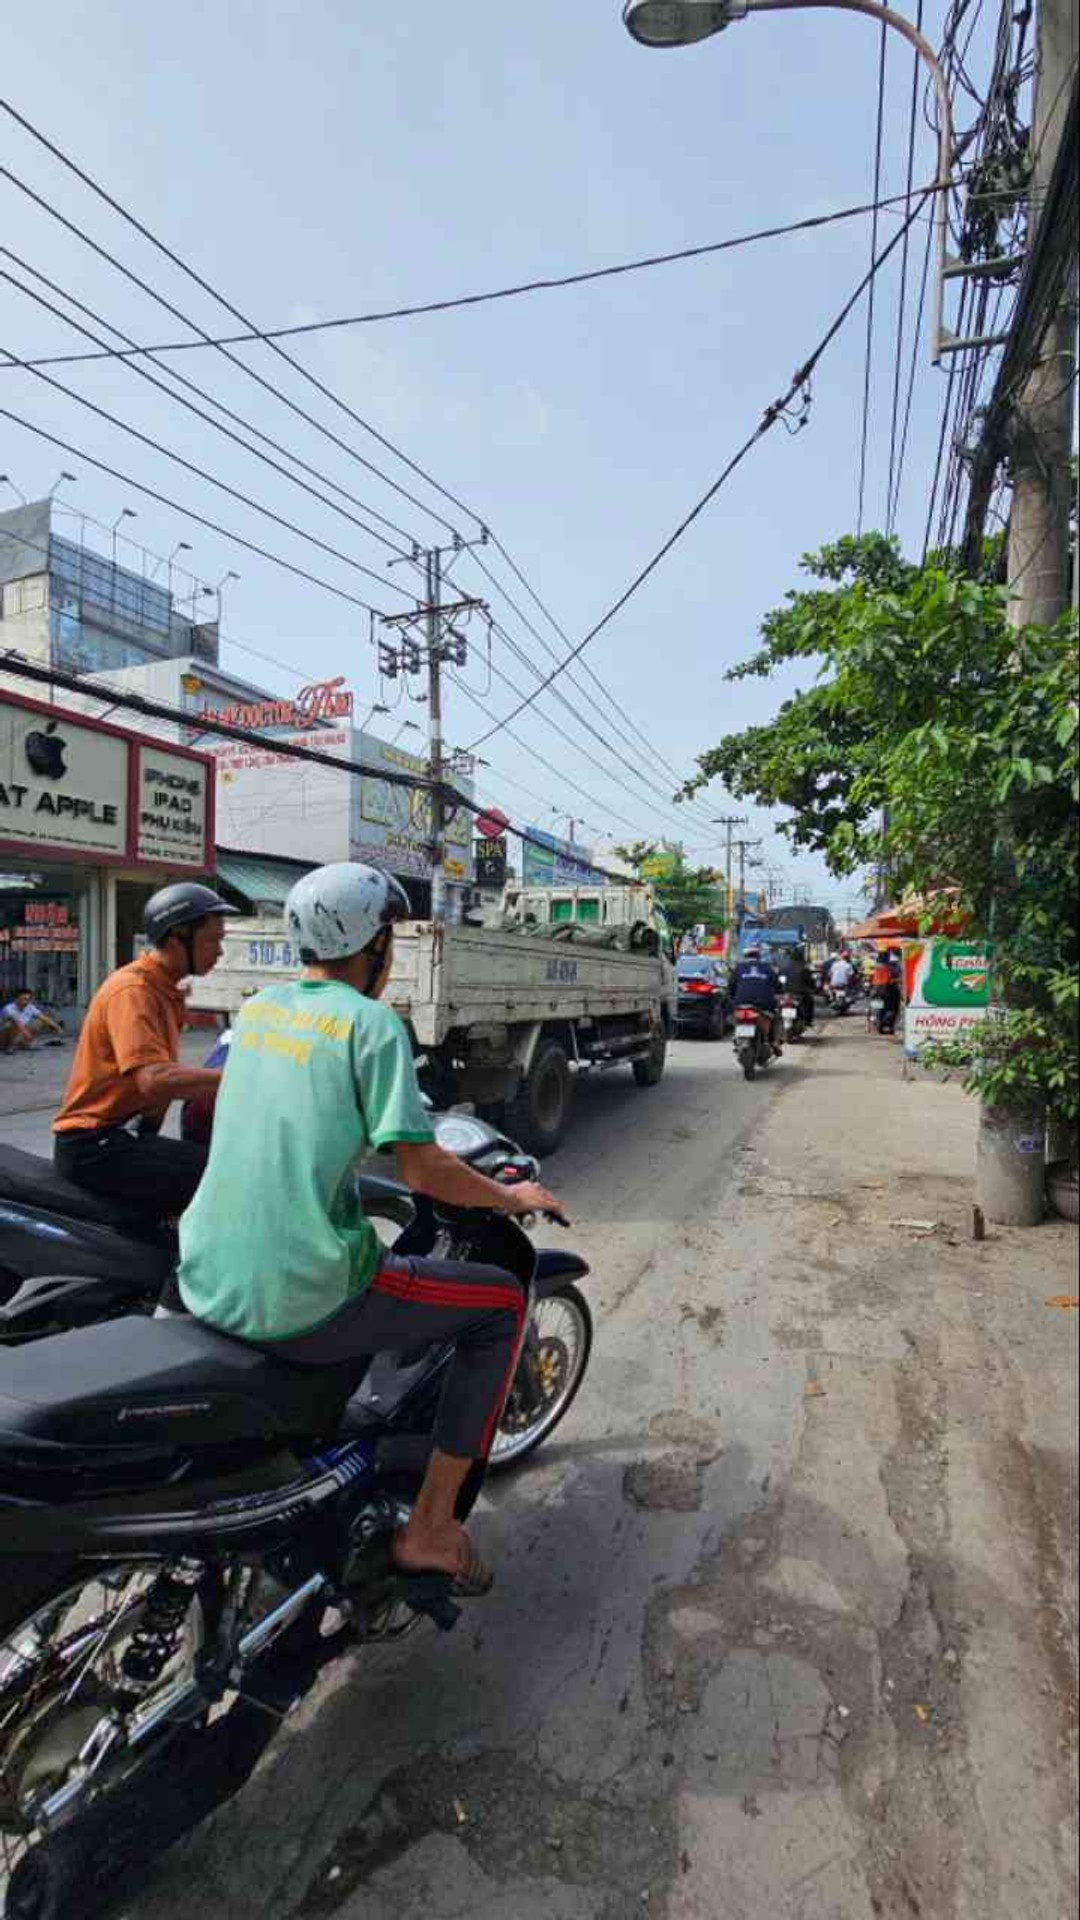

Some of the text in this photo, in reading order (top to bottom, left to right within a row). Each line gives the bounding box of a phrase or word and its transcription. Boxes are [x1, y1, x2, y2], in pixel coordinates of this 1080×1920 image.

[35, 791, 118, 826] APPLE
[154, 792, 192, 813] IPAD
[479, 840, 503, 859] SPA
